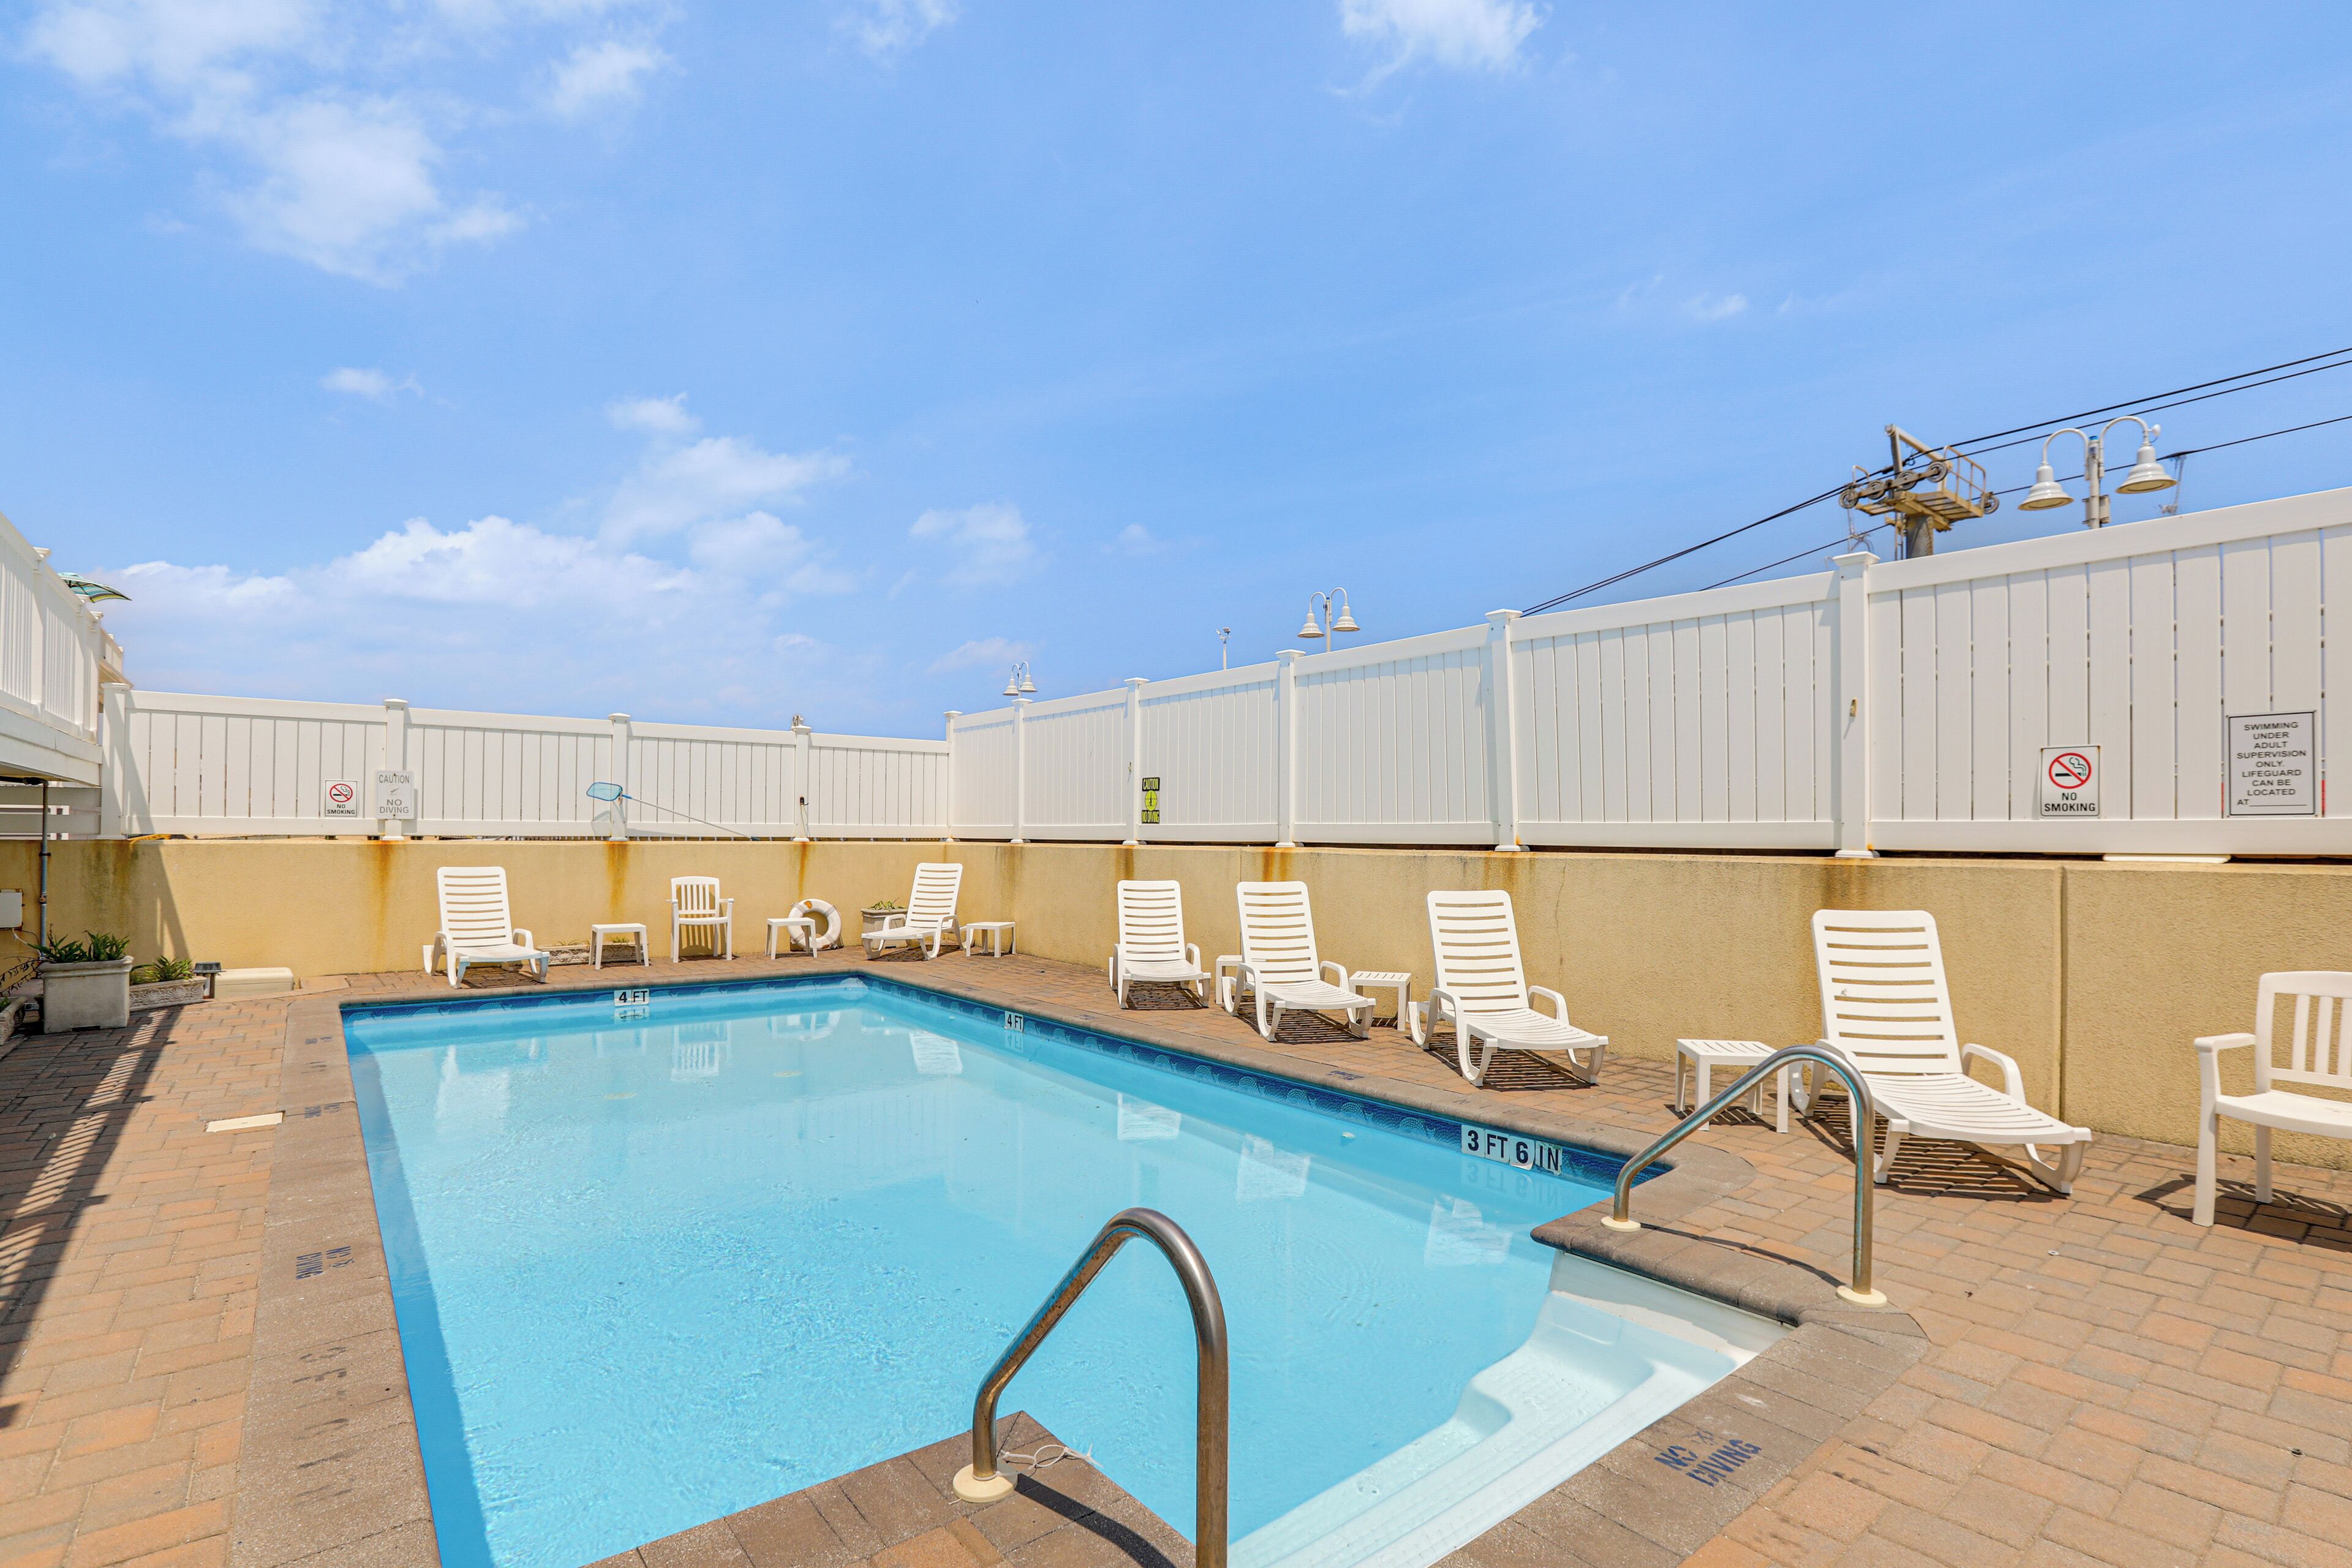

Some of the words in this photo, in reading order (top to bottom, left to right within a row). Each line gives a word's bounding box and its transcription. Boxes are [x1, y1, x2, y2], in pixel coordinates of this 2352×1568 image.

[2244, 722, 2299, 731] SWIMMING
[2237, 750, 2307, 759] SUPERVISION
[379, 774, 410, 783] CAUTION
[2242, 769, 2302, 778] LIFEGUARD
[1143, 778, 1159, 790] CAUTION
[2062, 792, 2077, 801] NO
[2044, 803, 2096, 812] SMOKING
[1142, 811, 1147, 823] NO
[1147, 811, 1159, 823] DIVING
[619, 992, 627, 1003] 4
[633, 990, 647, 1002] FT
[1008, 1014, 1012, 1027] 4
[1014, 1015, 1022, 1030] FT
[1468, 1130, 1479, 1152] 3
[1487, 1133, 1508, 1158] FT
[1515, 1141, 1529, 1164] 6
[1539, 1145, 1559, 1171] IN
[1654, 1446, 1698, 1471] NO
[1686, 1439, 1762, 1487] DIVING
